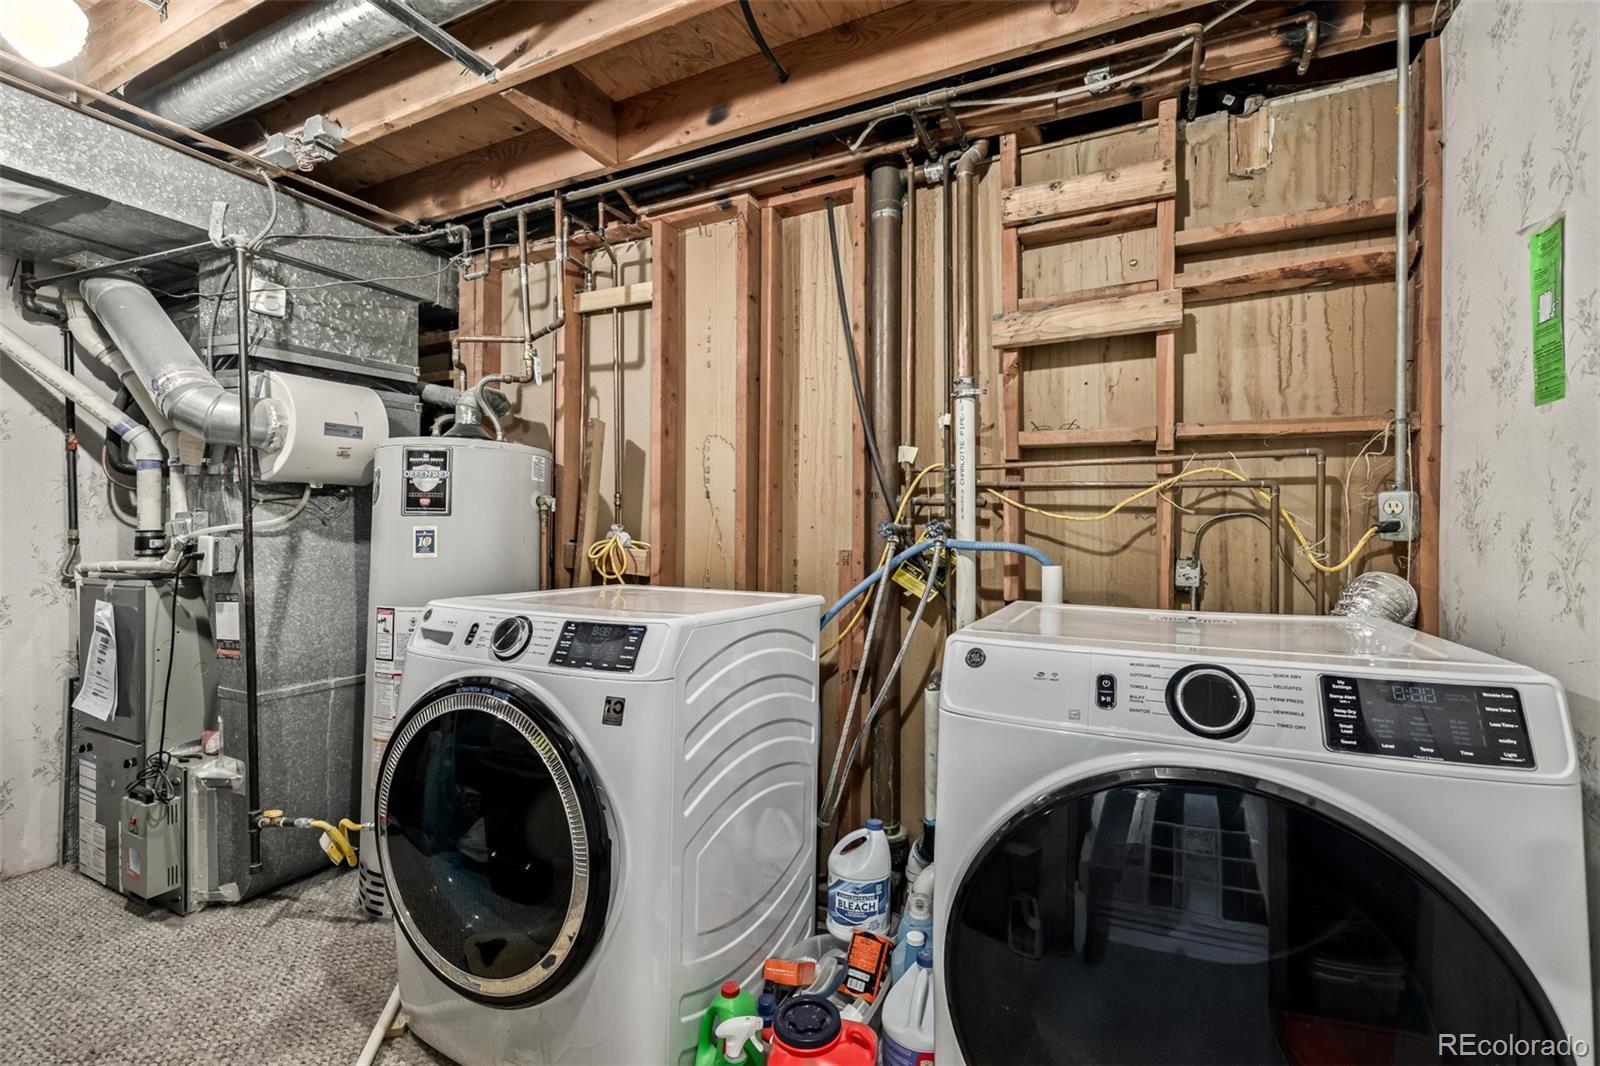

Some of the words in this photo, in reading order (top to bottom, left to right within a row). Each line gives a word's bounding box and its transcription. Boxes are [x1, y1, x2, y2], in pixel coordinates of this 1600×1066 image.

[1273, 684, 1303, 692] DELICATES
[1273, 709, 1305, 717] DEWRINKLE
[837, 899, 876, 911] BLEACH
